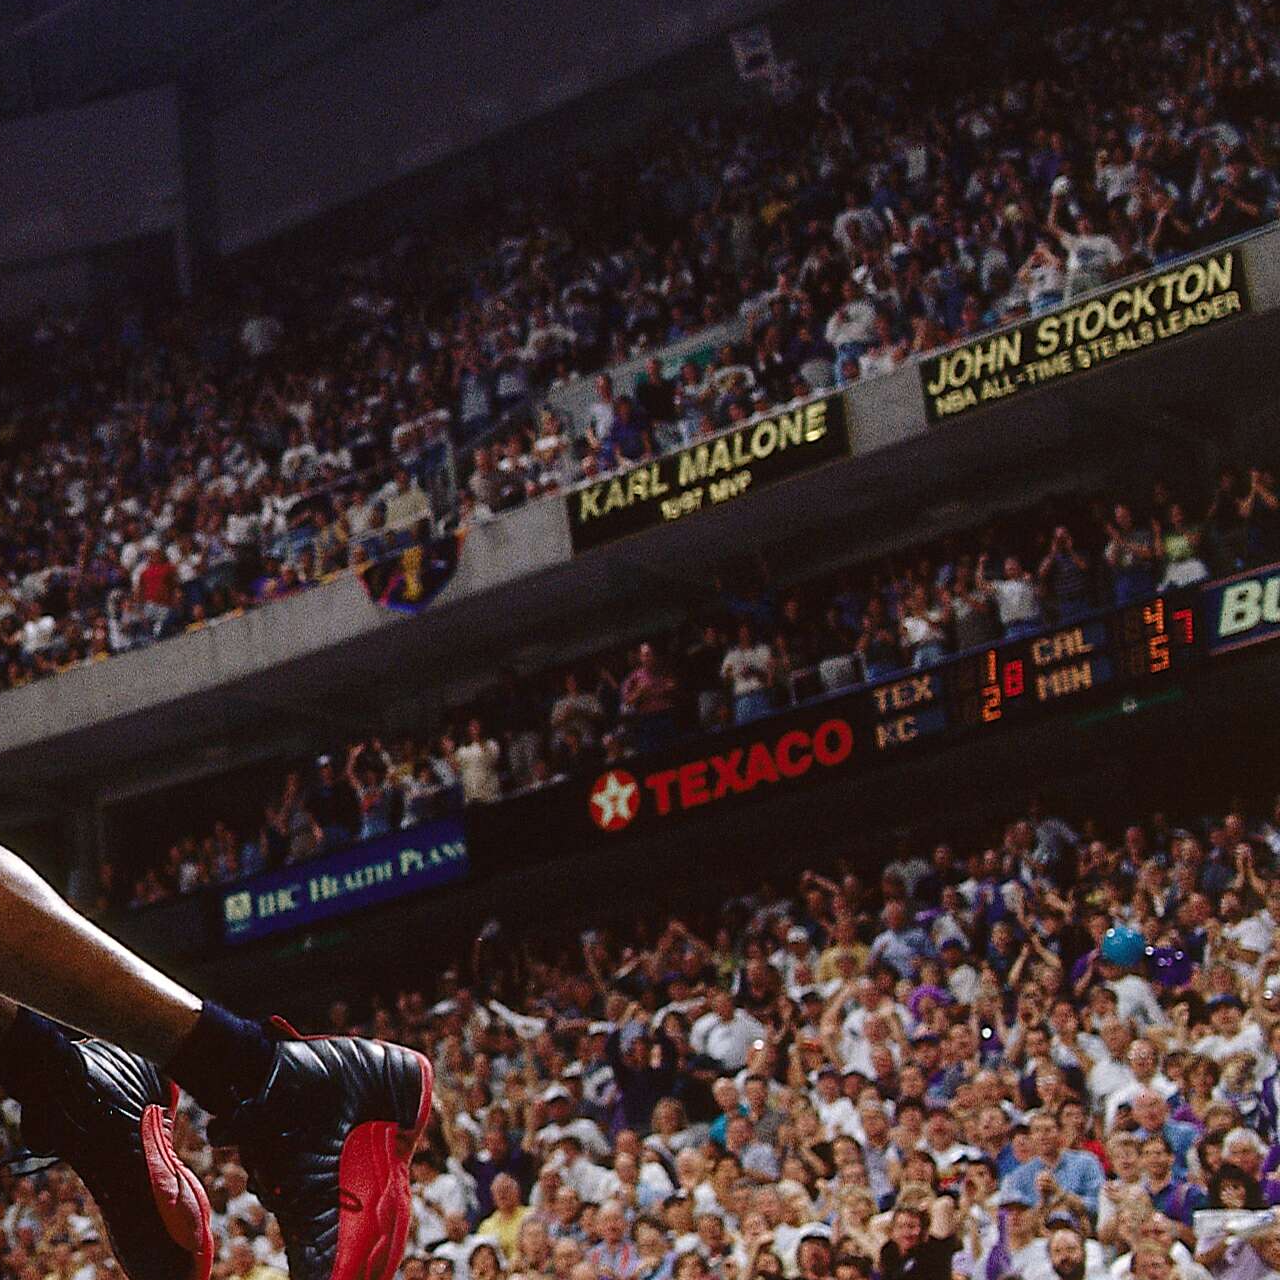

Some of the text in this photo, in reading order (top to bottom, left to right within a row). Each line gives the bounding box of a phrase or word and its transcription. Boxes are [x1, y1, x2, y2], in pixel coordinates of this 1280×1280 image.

[928, 252, 1233, 396] JOHN STOCKTON
[935, 387, 978, 416] NBA
[1075, 321, 1155, 370] STEALS
[1156, 290, 1241, 339] LEADER
[579, 400, 828, 521] KARL MALONE
[872, 675, 934, 712] TEX
[1031, 627, 1095, 665] CAL
[645, 720, 853, 816] TEXACO
